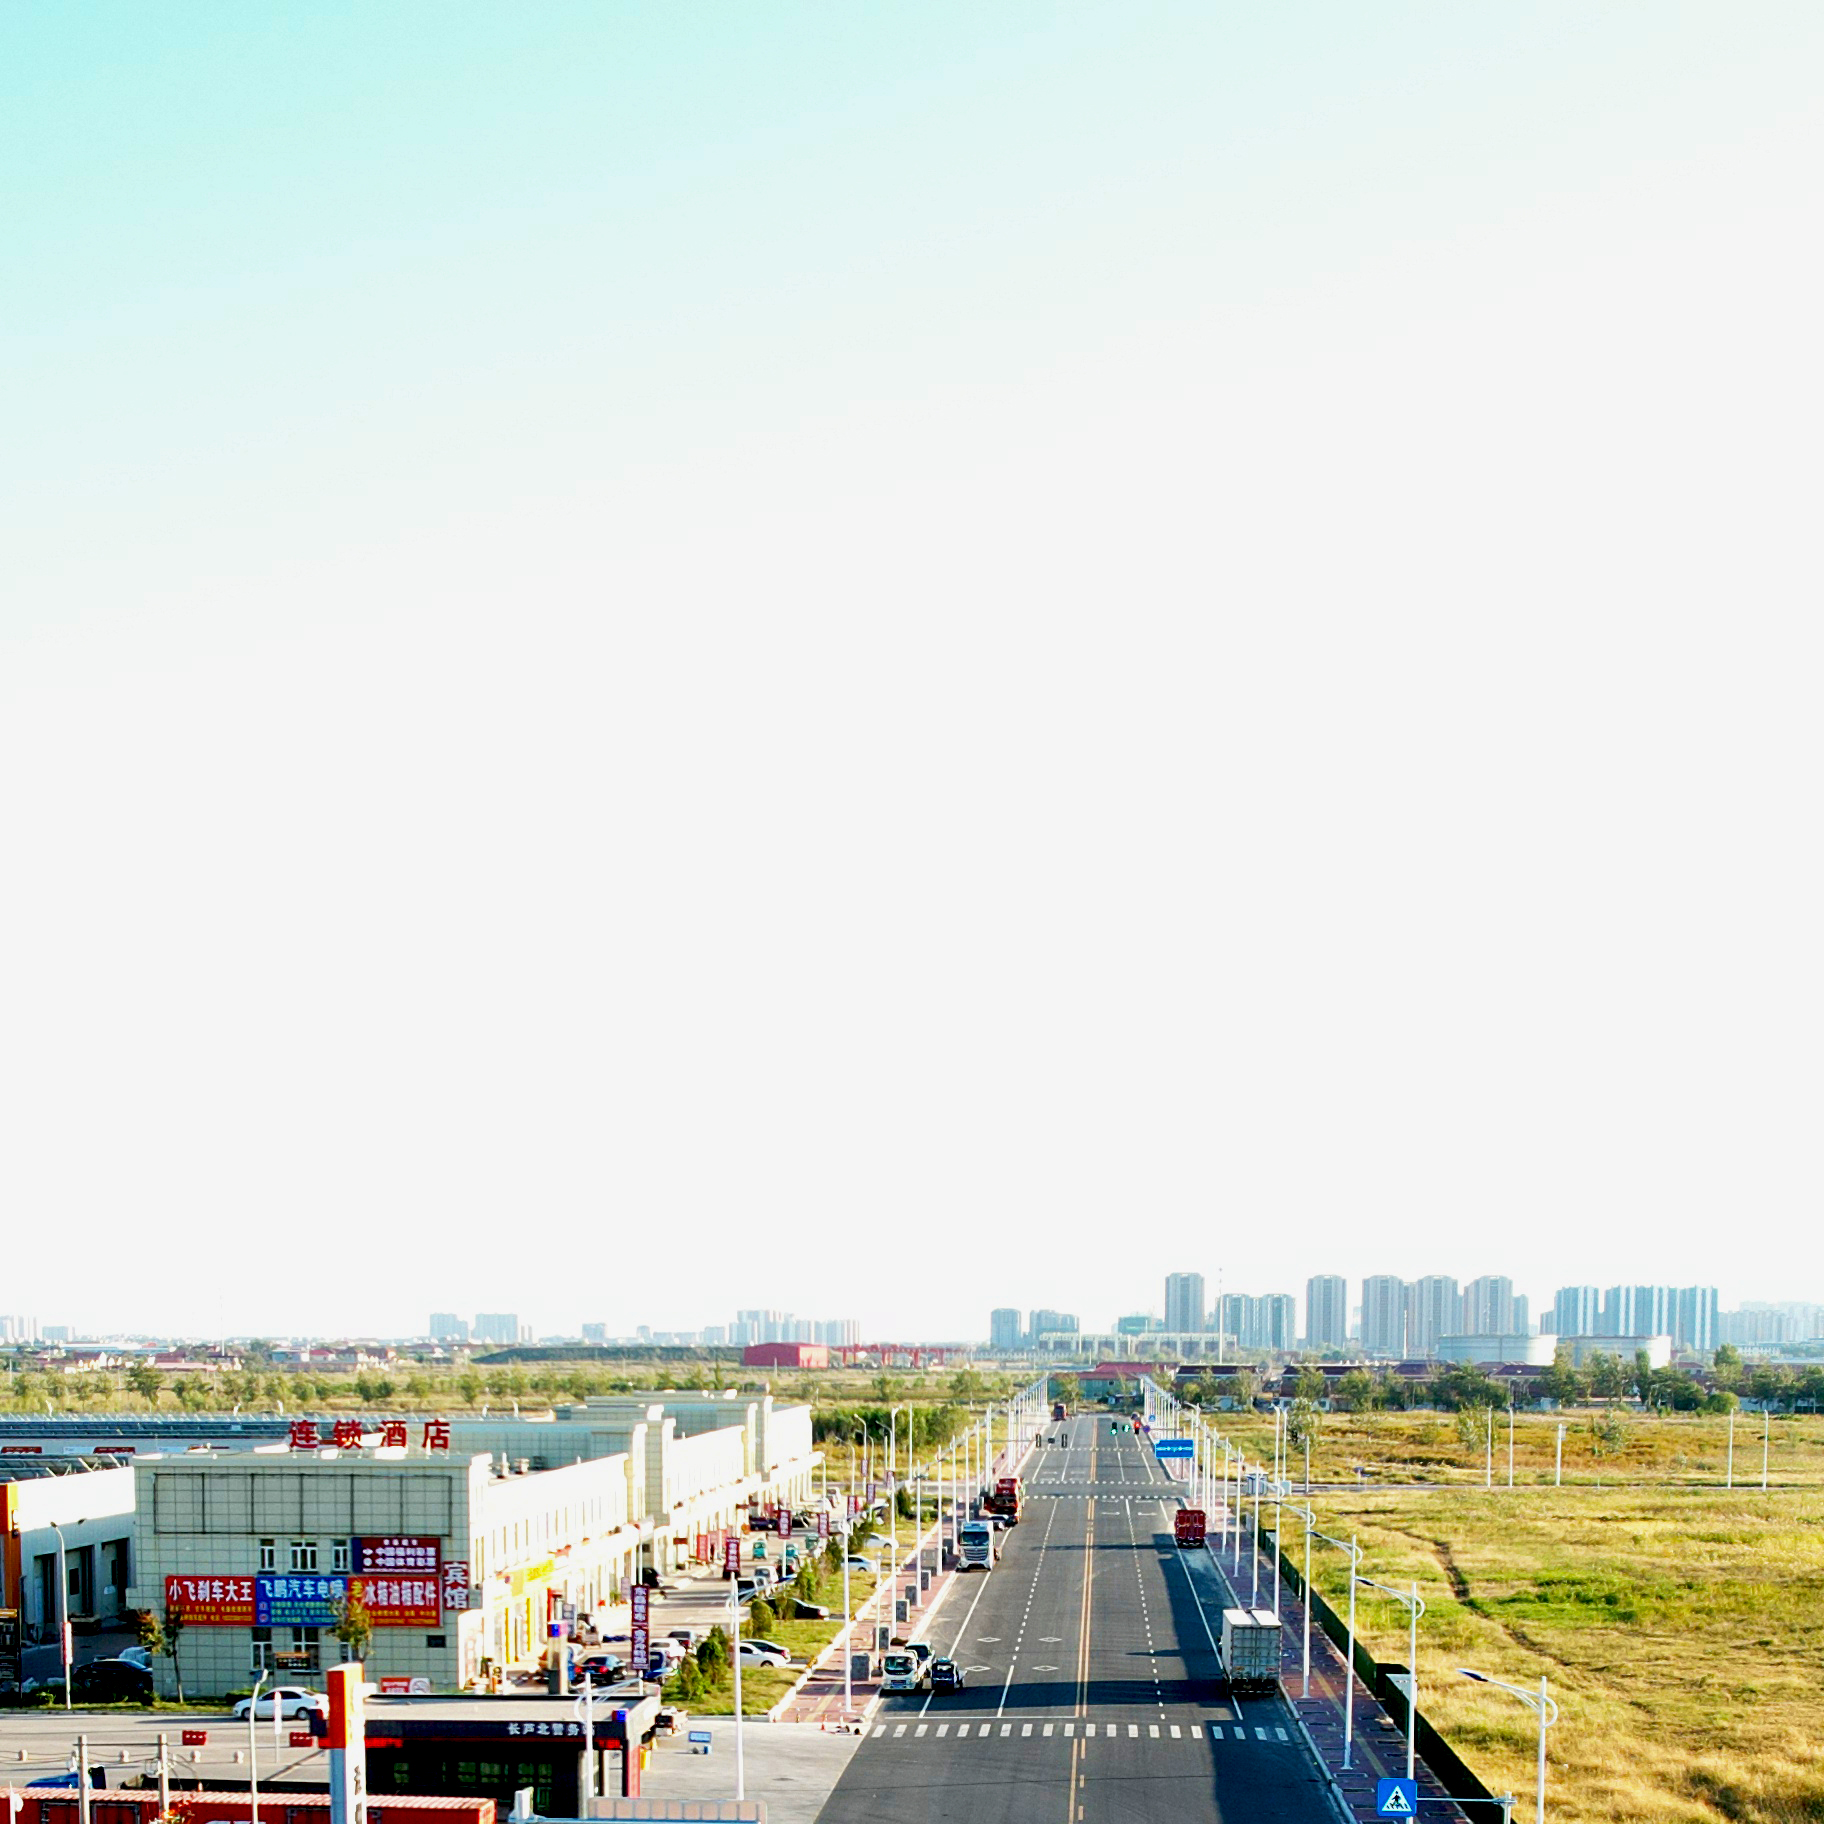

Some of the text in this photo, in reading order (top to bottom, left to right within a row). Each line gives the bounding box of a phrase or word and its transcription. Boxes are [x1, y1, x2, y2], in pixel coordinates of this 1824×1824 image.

[288, 1419, 451, 1450] 连锁酒店
[168, 1578, 254, 1603] 小飞刹车大王
[443, 1562, 468, 1609] 宾馆
